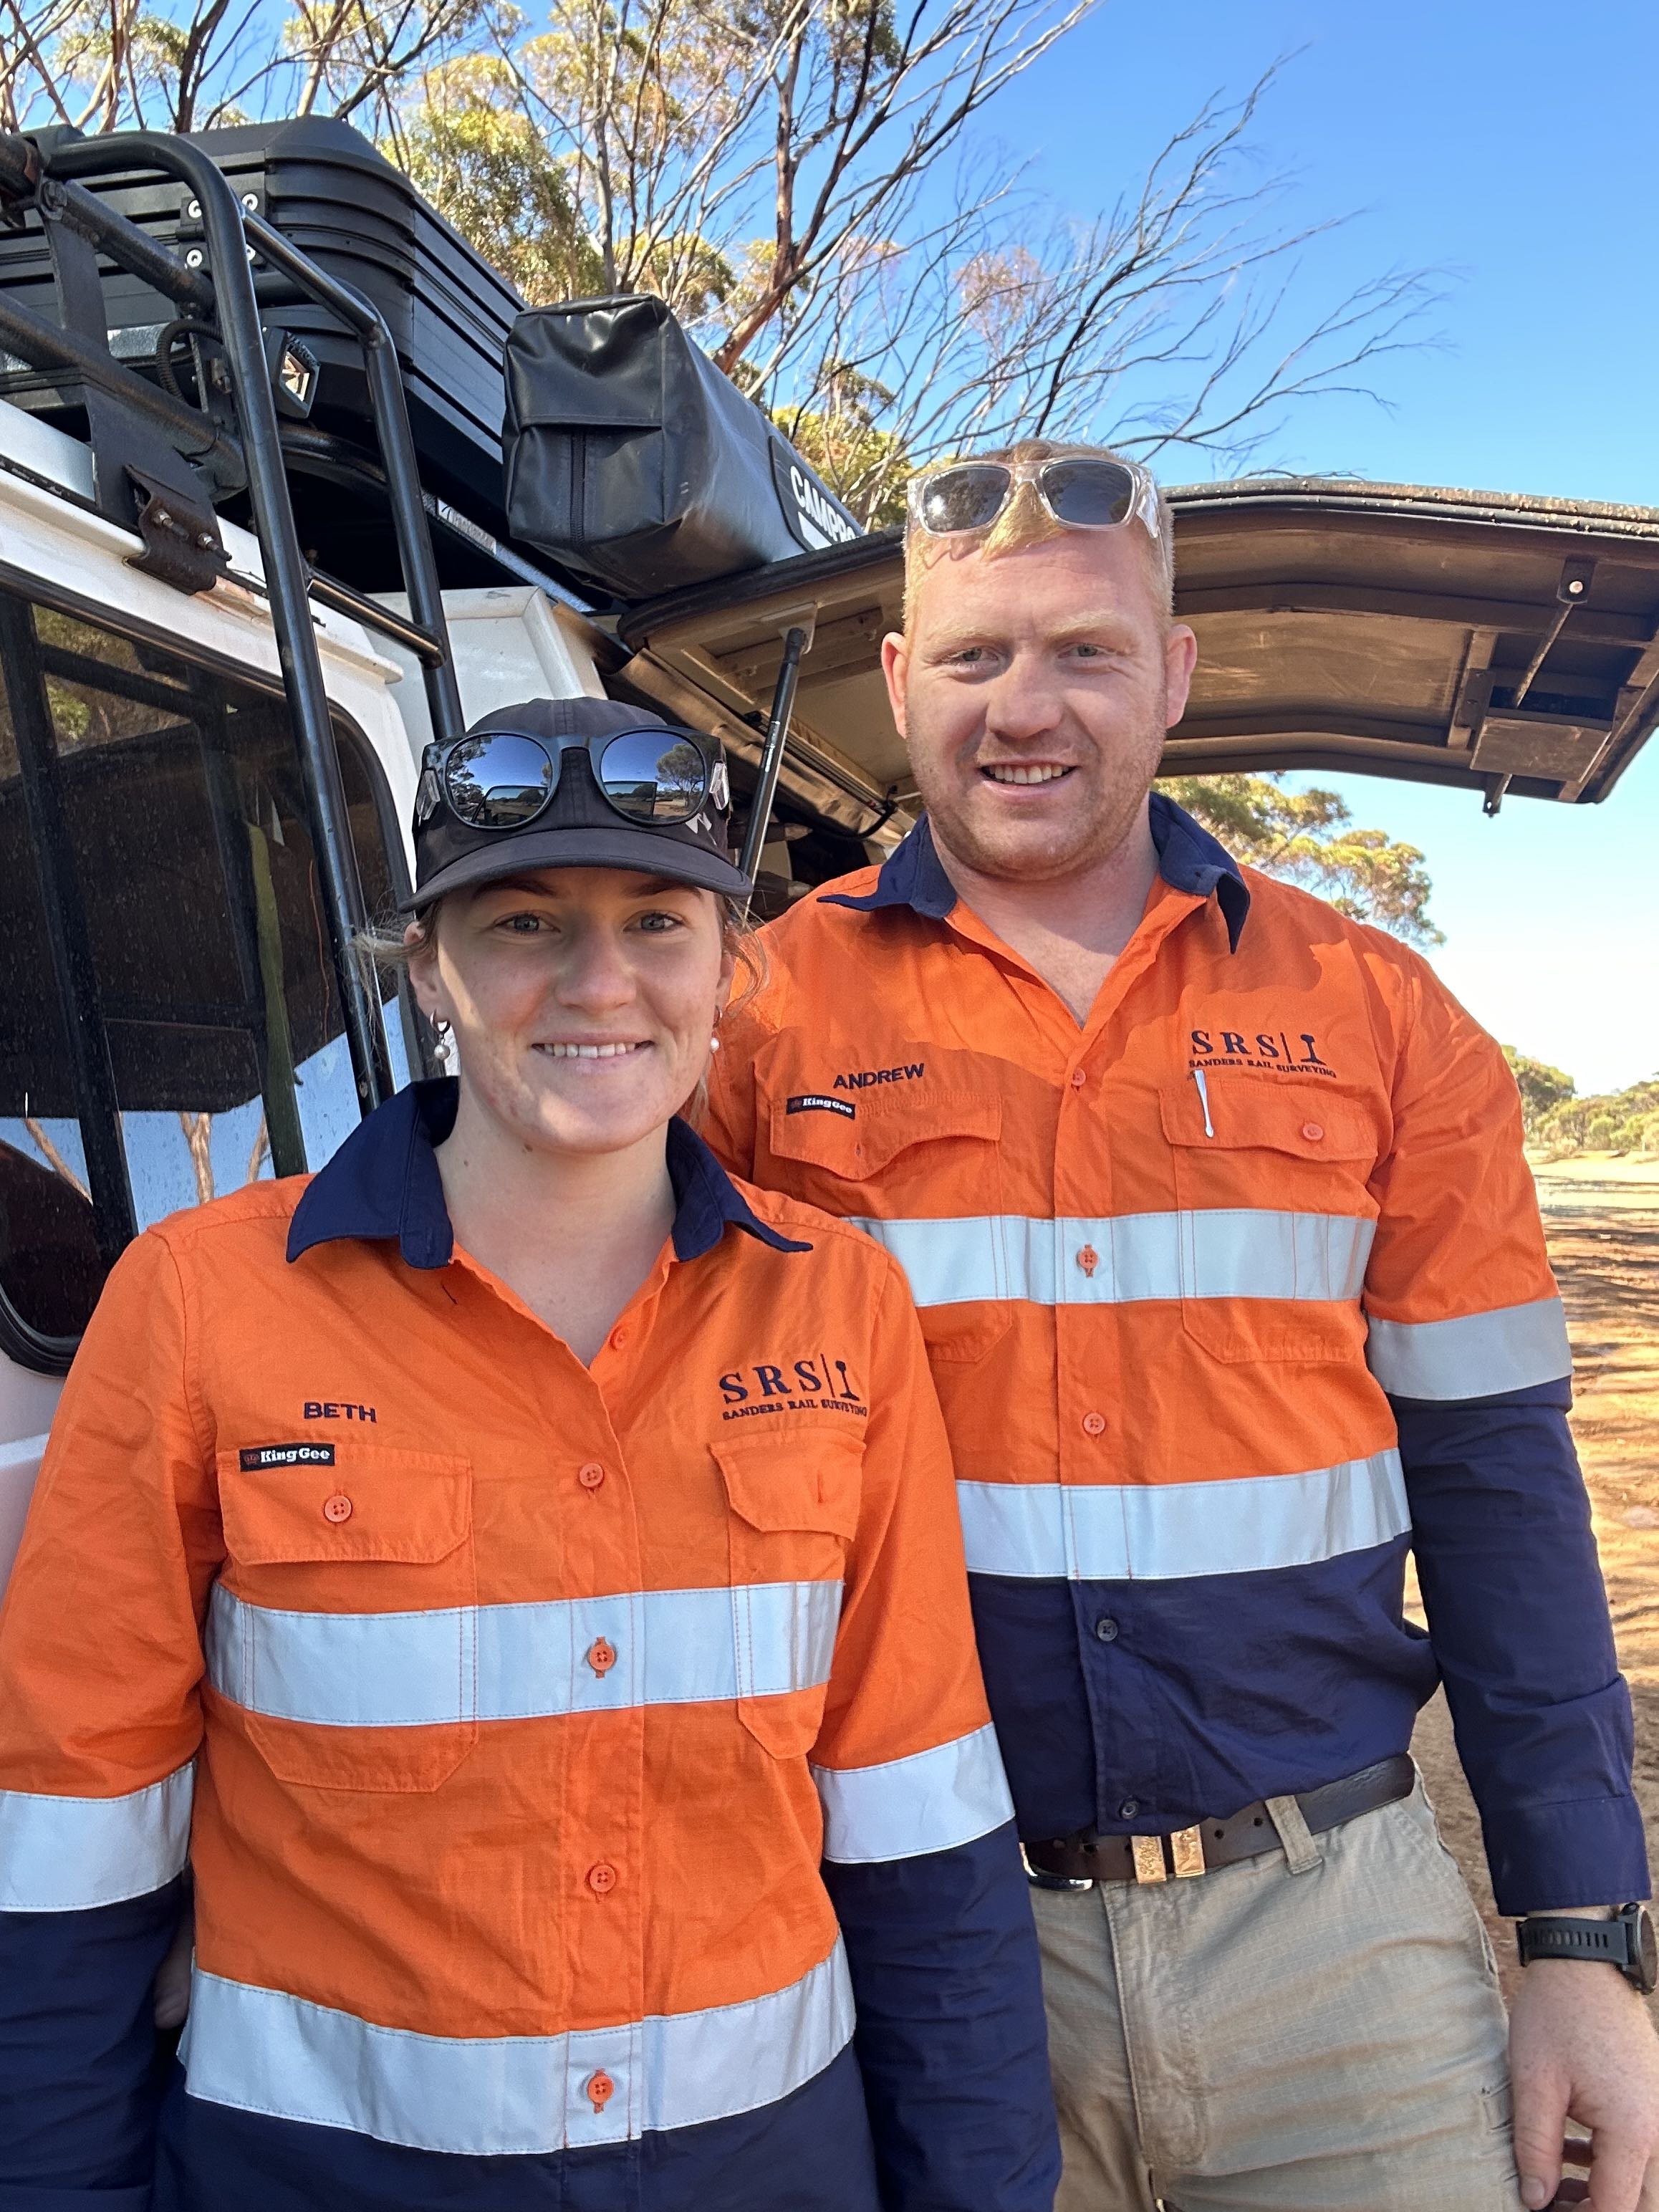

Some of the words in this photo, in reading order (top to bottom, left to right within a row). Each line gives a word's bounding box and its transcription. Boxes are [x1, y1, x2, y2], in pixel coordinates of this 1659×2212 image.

[832, 1062, 925, 1090] ANDREW
[1188, 1058, 1244, 1068] SANDERS
[1246, 1059, 1274, 1069] RAIL
[1276, 1064, 1337, 1079] SURVEYING
[802, 1097, 853, 1114] KingGee
[304, 1401, 378, 1424] BETH
[722, 1402, 784, 1421] SANDERS
[787, 1398, 819, 1410] RAIL
[821, 1399, 867, 1418] SURVEYING
[259, 1447, 331, 1463] KingGee
